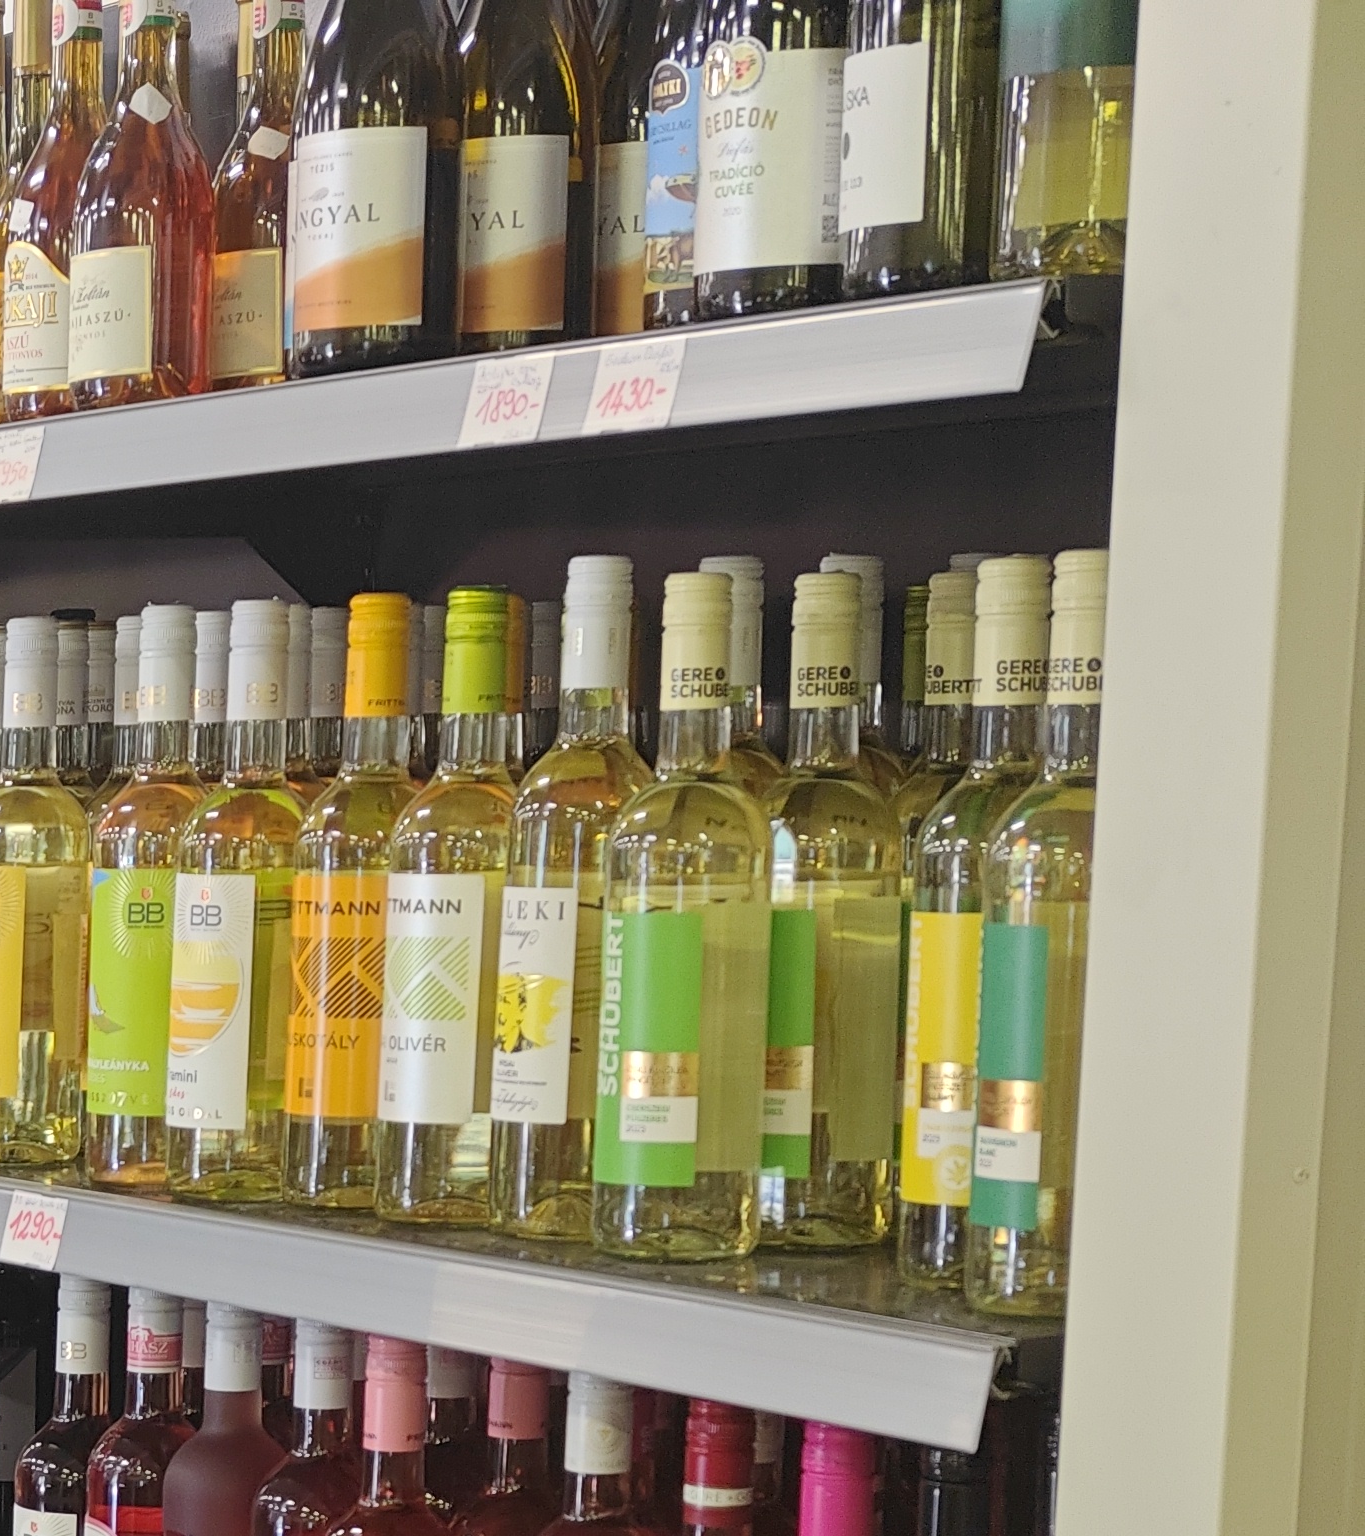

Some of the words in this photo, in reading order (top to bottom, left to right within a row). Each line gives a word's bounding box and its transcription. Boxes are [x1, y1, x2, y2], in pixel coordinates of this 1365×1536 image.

[705, 107, 778, 139] GEDEON
[709, 162, 764, 185] TRADÍCIÓ
[715, 182, 754, 199] CUVÉE
[296, 203, 380, 232] NGYAL
[671, 667, 713, 682] GERE
[797, 667, 837, 681] GERE
[127, 903, 164, 923] BB
[190, 905, 222, 927] BB
[600, 913, 624, 1097] SCHUBERT
[389, 1033, 446, 1052] OLIVÉR
